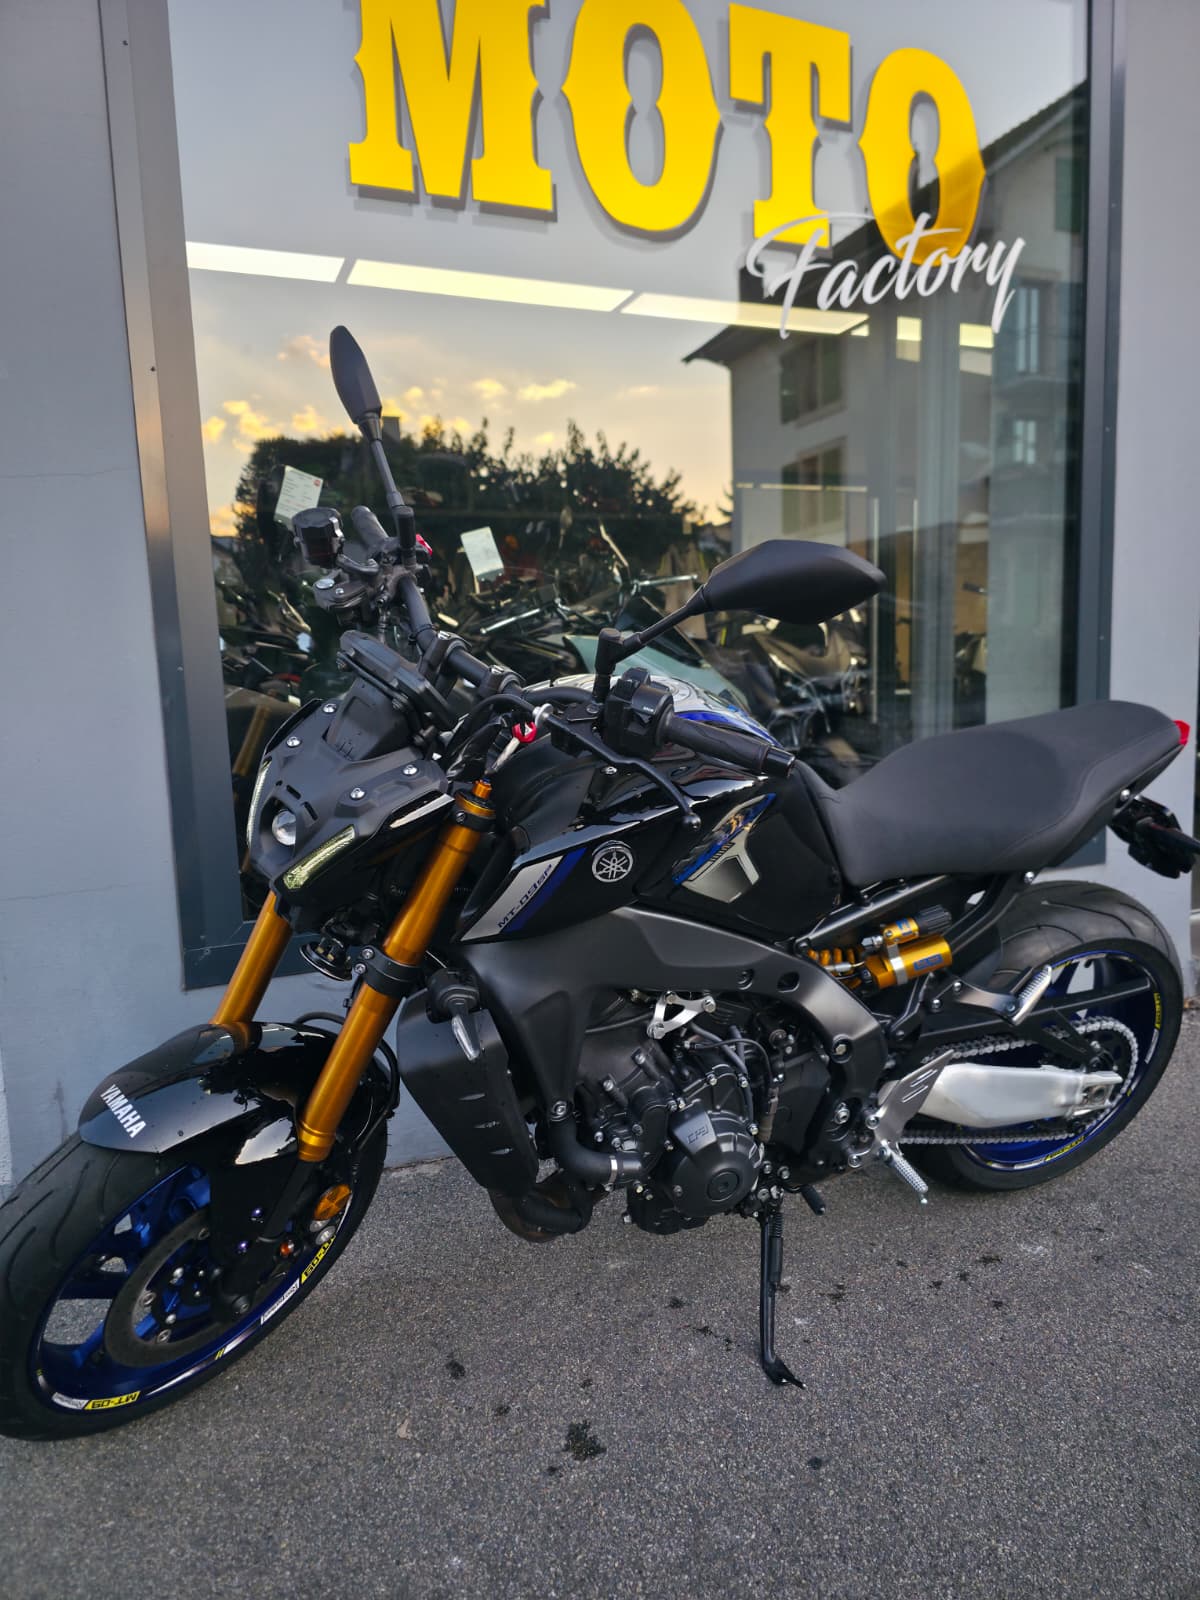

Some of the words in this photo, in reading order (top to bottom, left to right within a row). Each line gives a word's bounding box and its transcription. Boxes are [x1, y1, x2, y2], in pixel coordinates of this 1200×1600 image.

[348, 0, 985, 266] MOTO
[746, 211, 1026, 340] Factory
[100, 1083, 147, 1139] YAMAHA
[92, 1392, 138, 1409] MT-09
